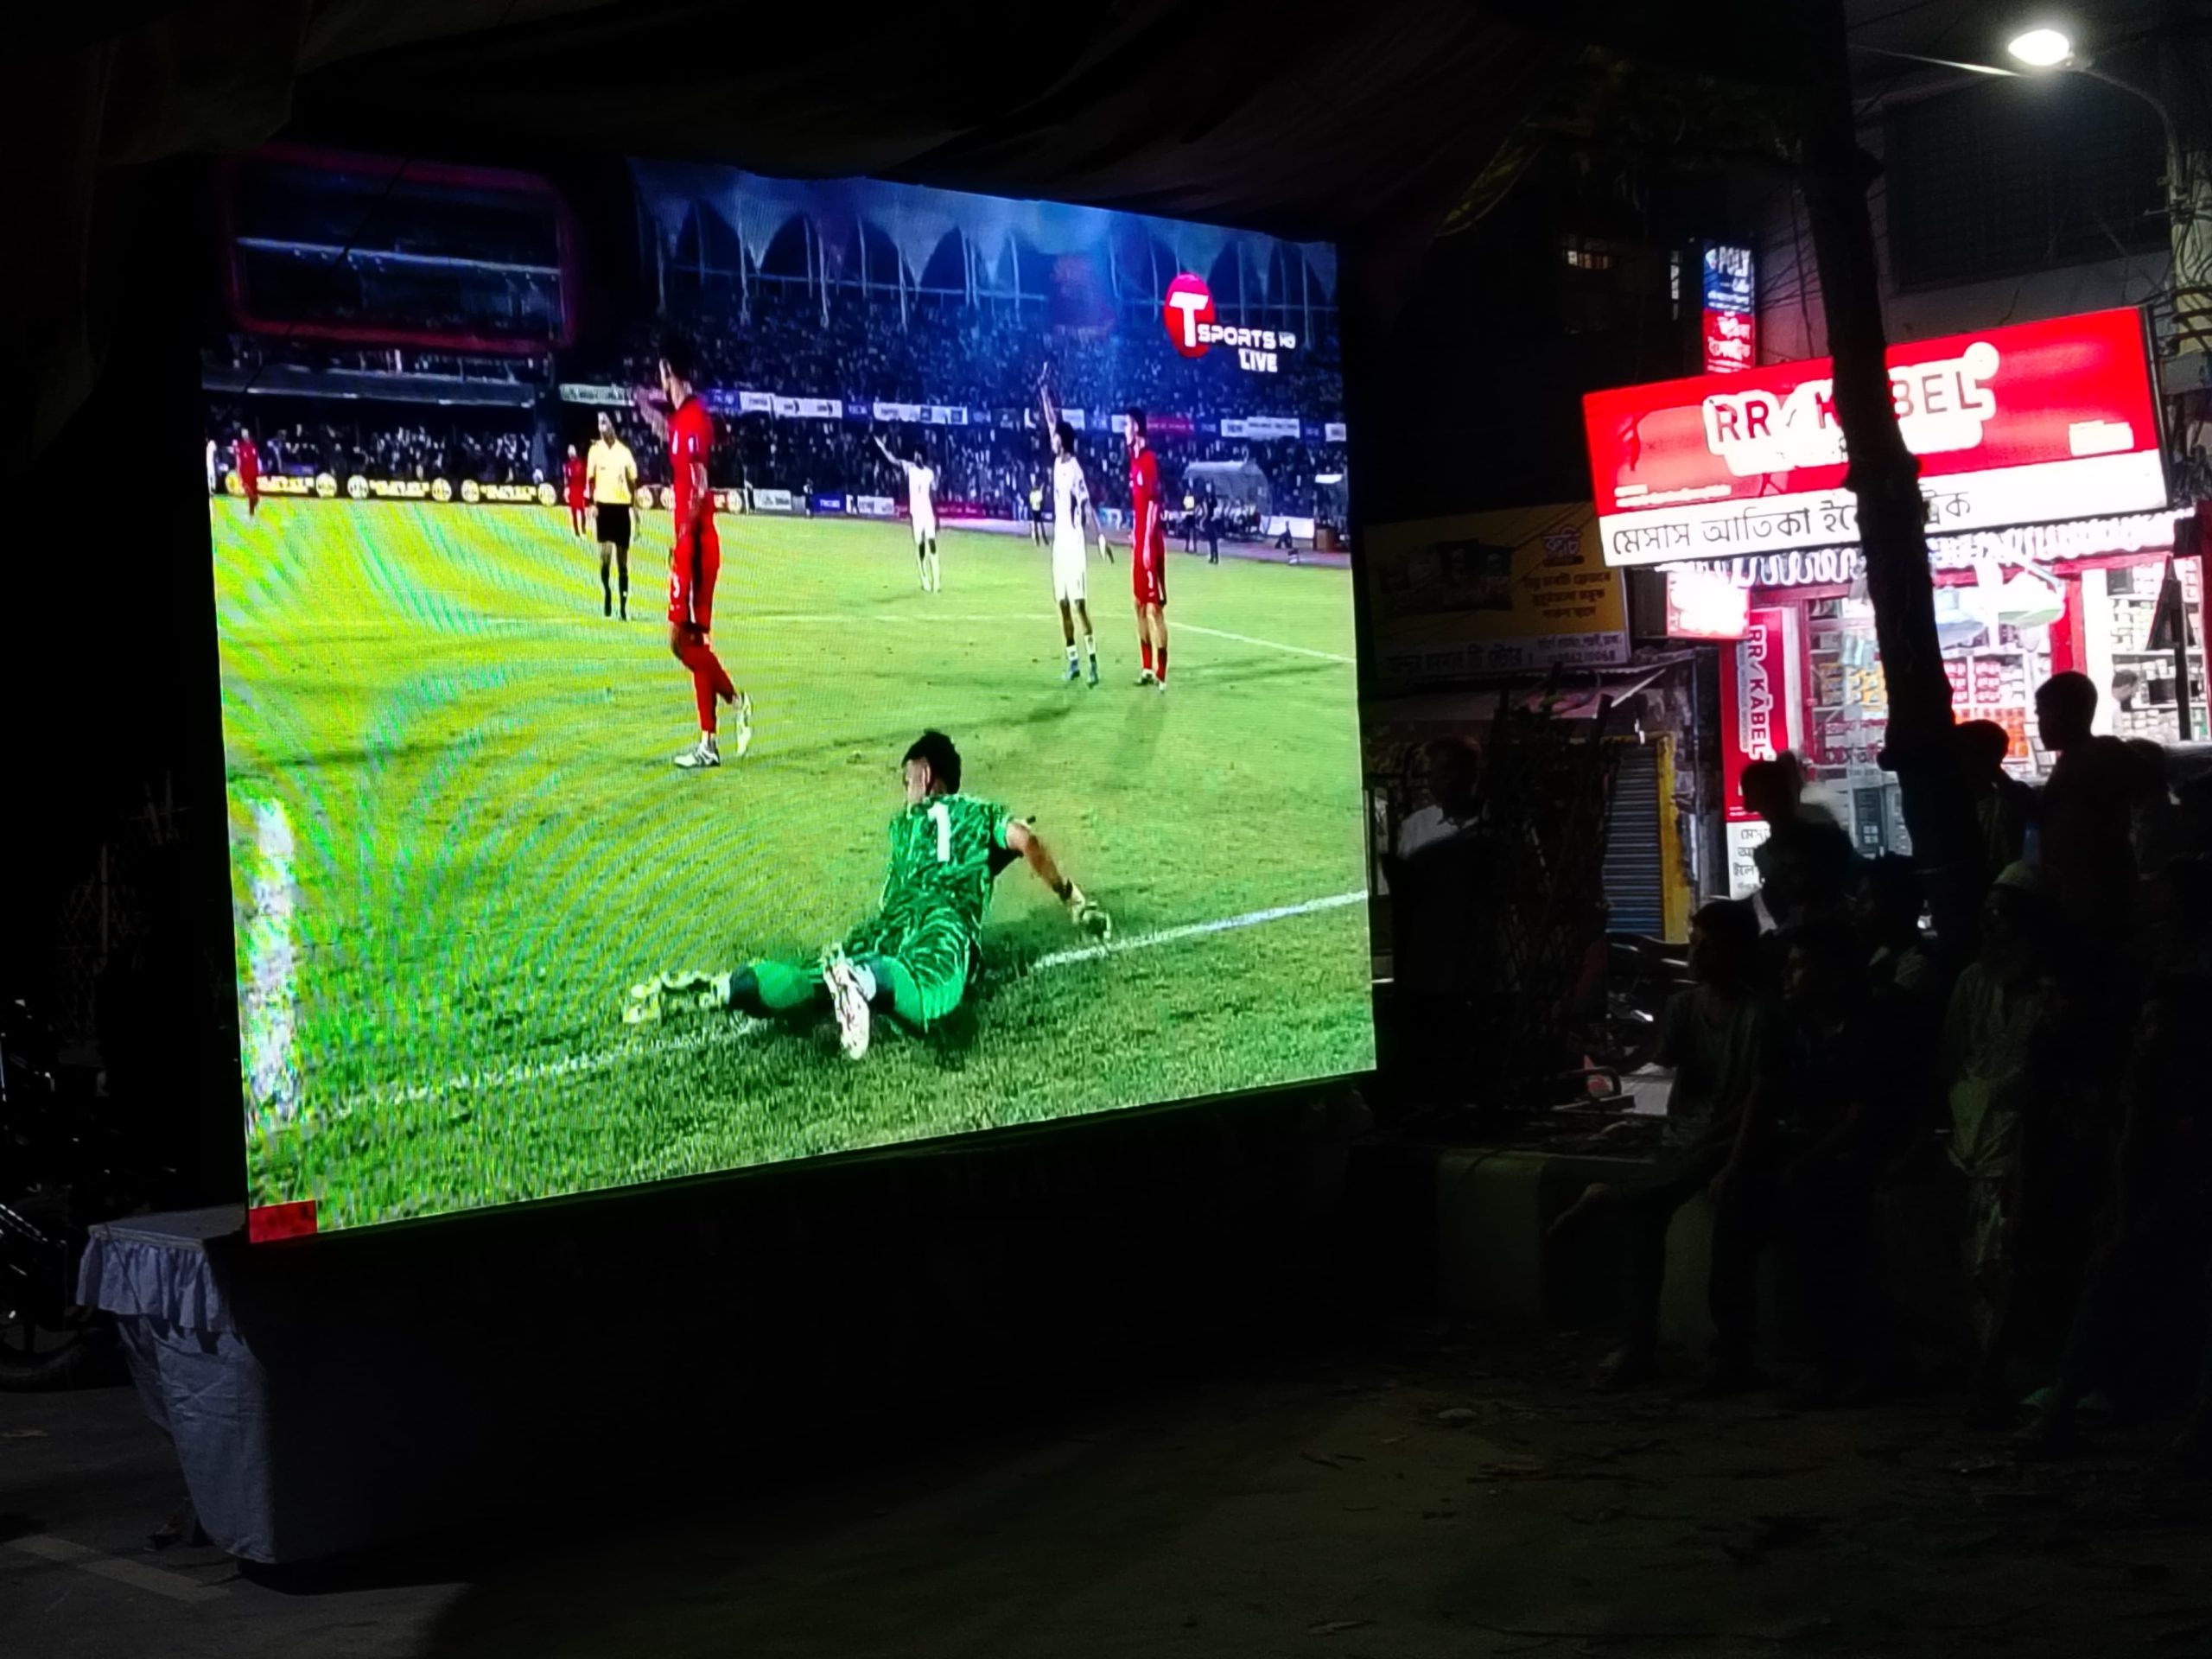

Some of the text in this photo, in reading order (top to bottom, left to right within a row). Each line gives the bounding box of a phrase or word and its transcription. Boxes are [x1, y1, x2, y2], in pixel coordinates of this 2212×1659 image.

[1169, 291, 1209, 347] T
[1198, 324, 1277, 350] SPORTS
[1238, 348, 1278, 372] LIVE
[1714, 371, 1983, 443] RR KBEL
[1701, 506, 1811, 542] আতিকা
[1747, 629, 1764, 658] RR
[927, 802, 951, 862] 1
